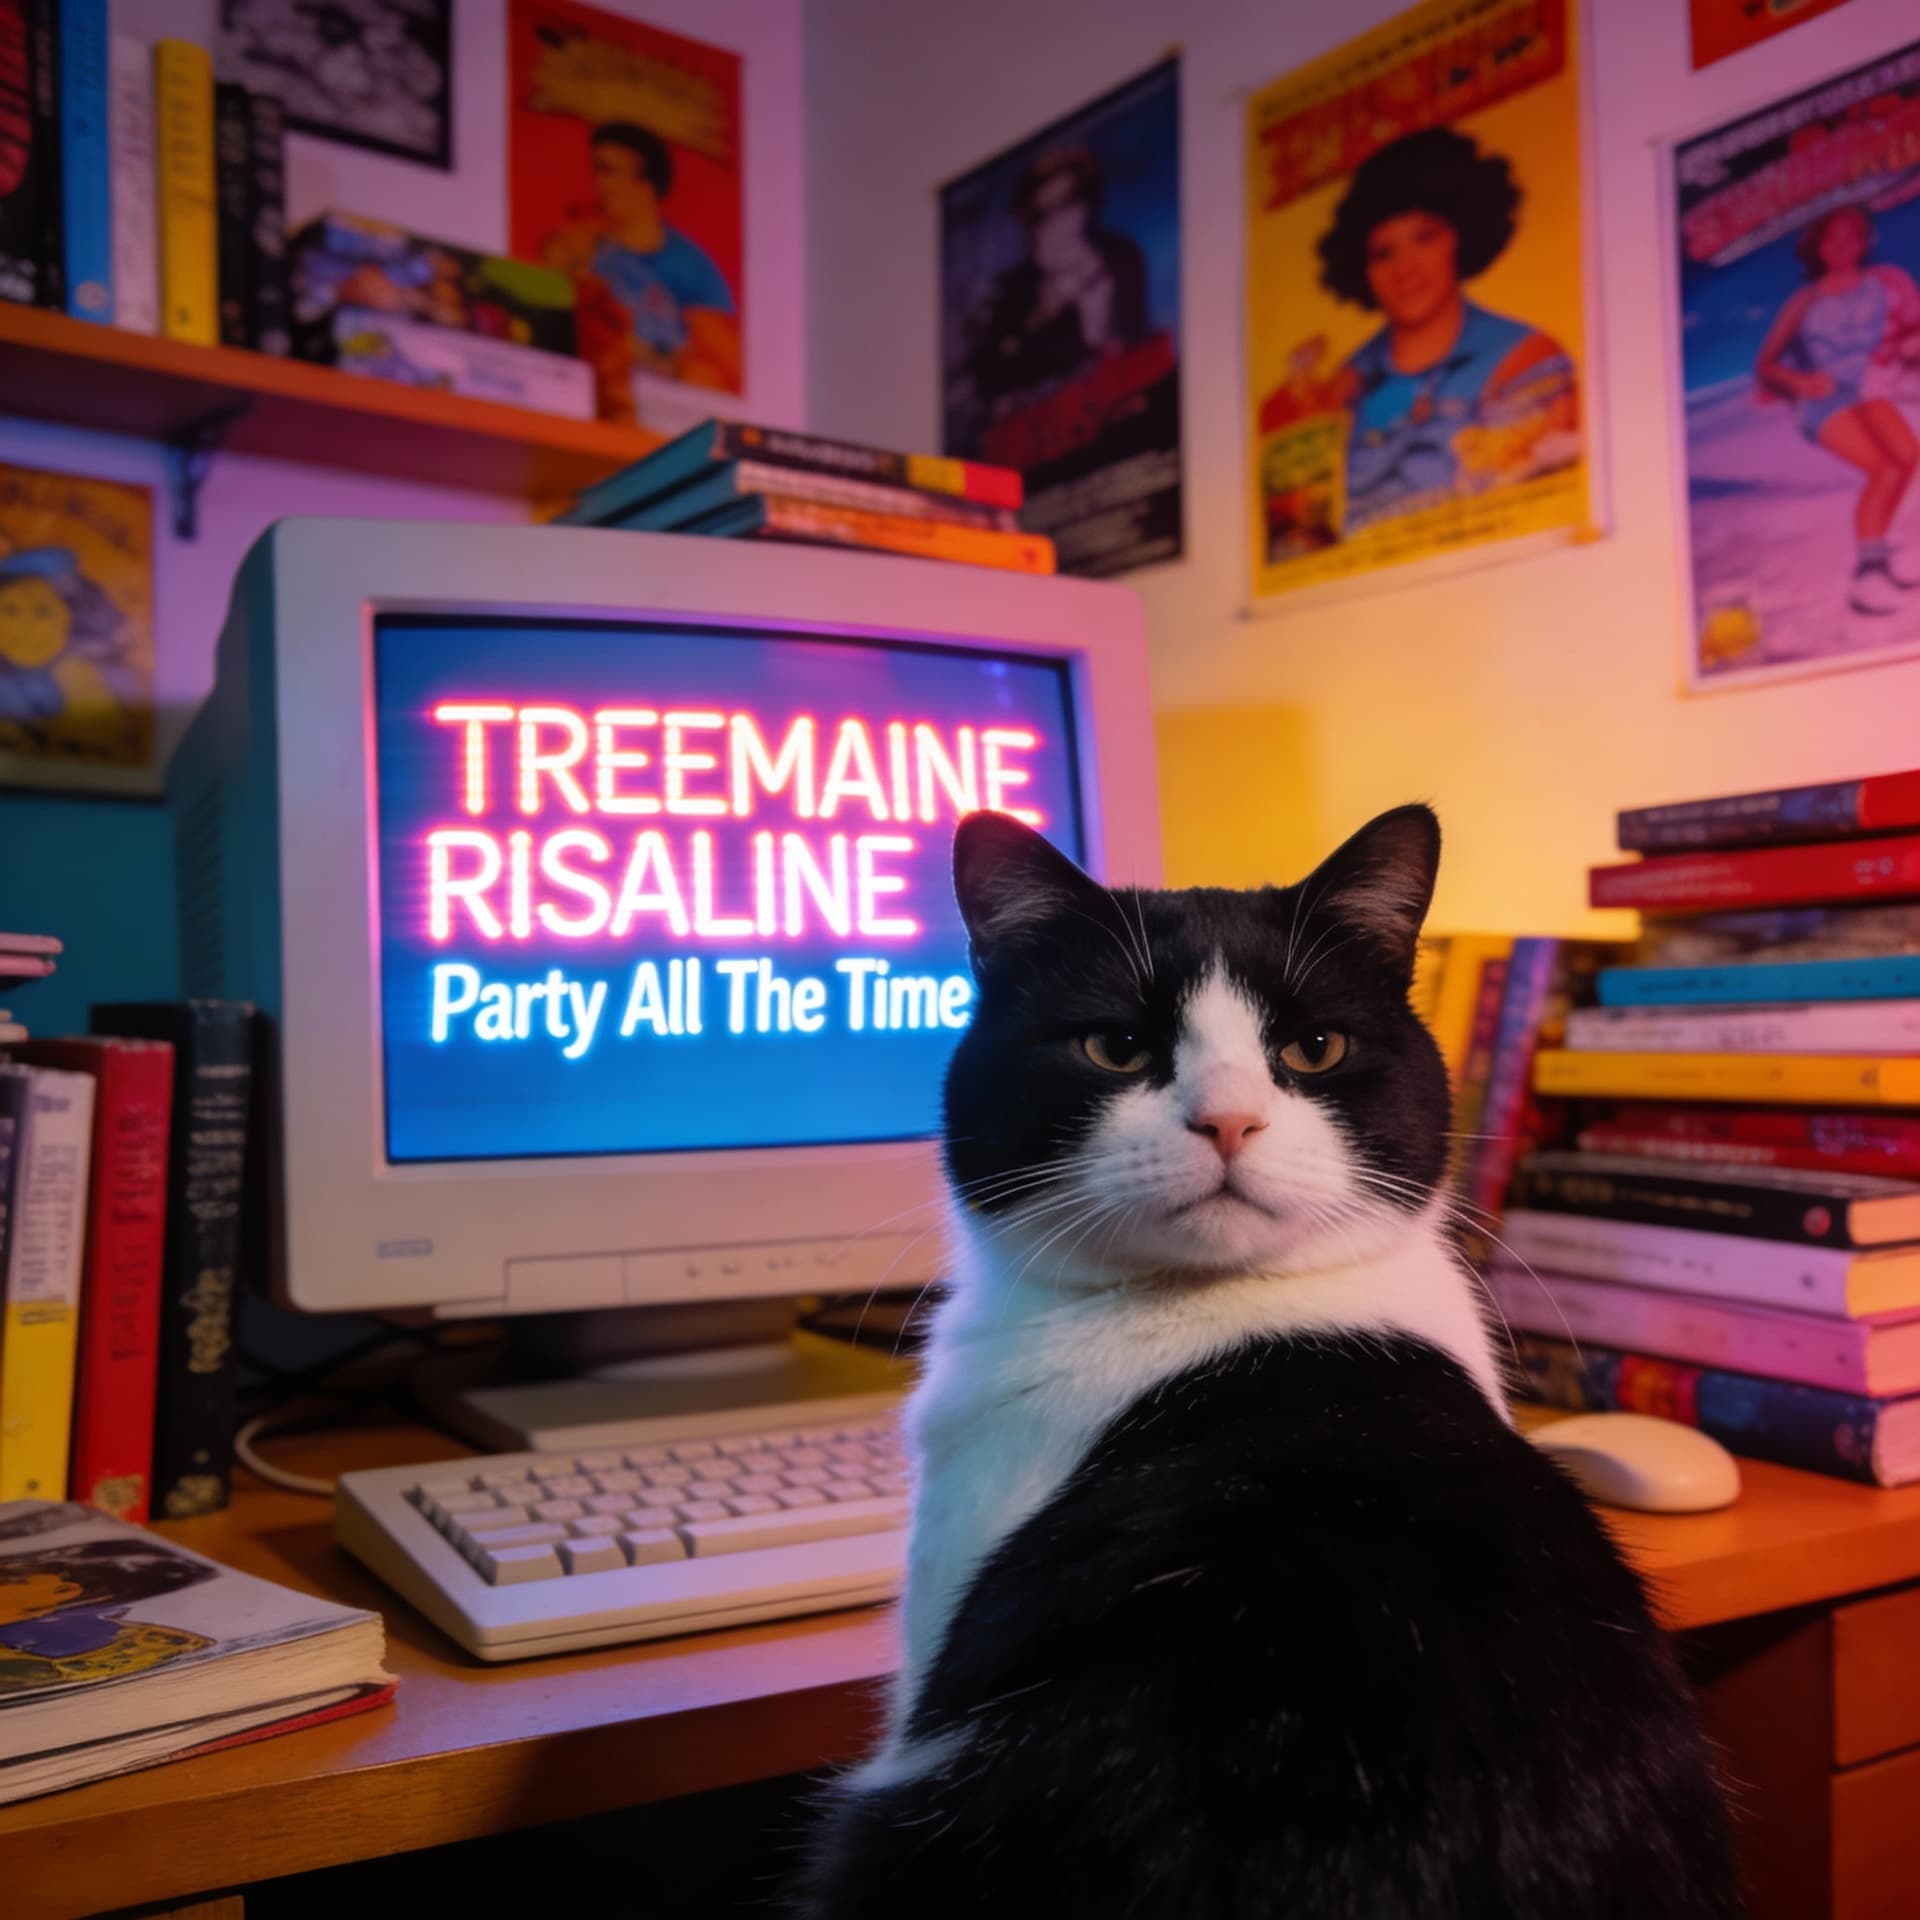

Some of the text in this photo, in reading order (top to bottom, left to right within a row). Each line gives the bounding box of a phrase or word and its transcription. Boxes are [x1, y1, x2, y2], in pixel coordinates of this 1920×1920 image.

[434, 705, 1043, 825] TREEMAINE
[427, 828, 918, 940] RISALINE
[430, 958, 971, 1059] Party All The Time
